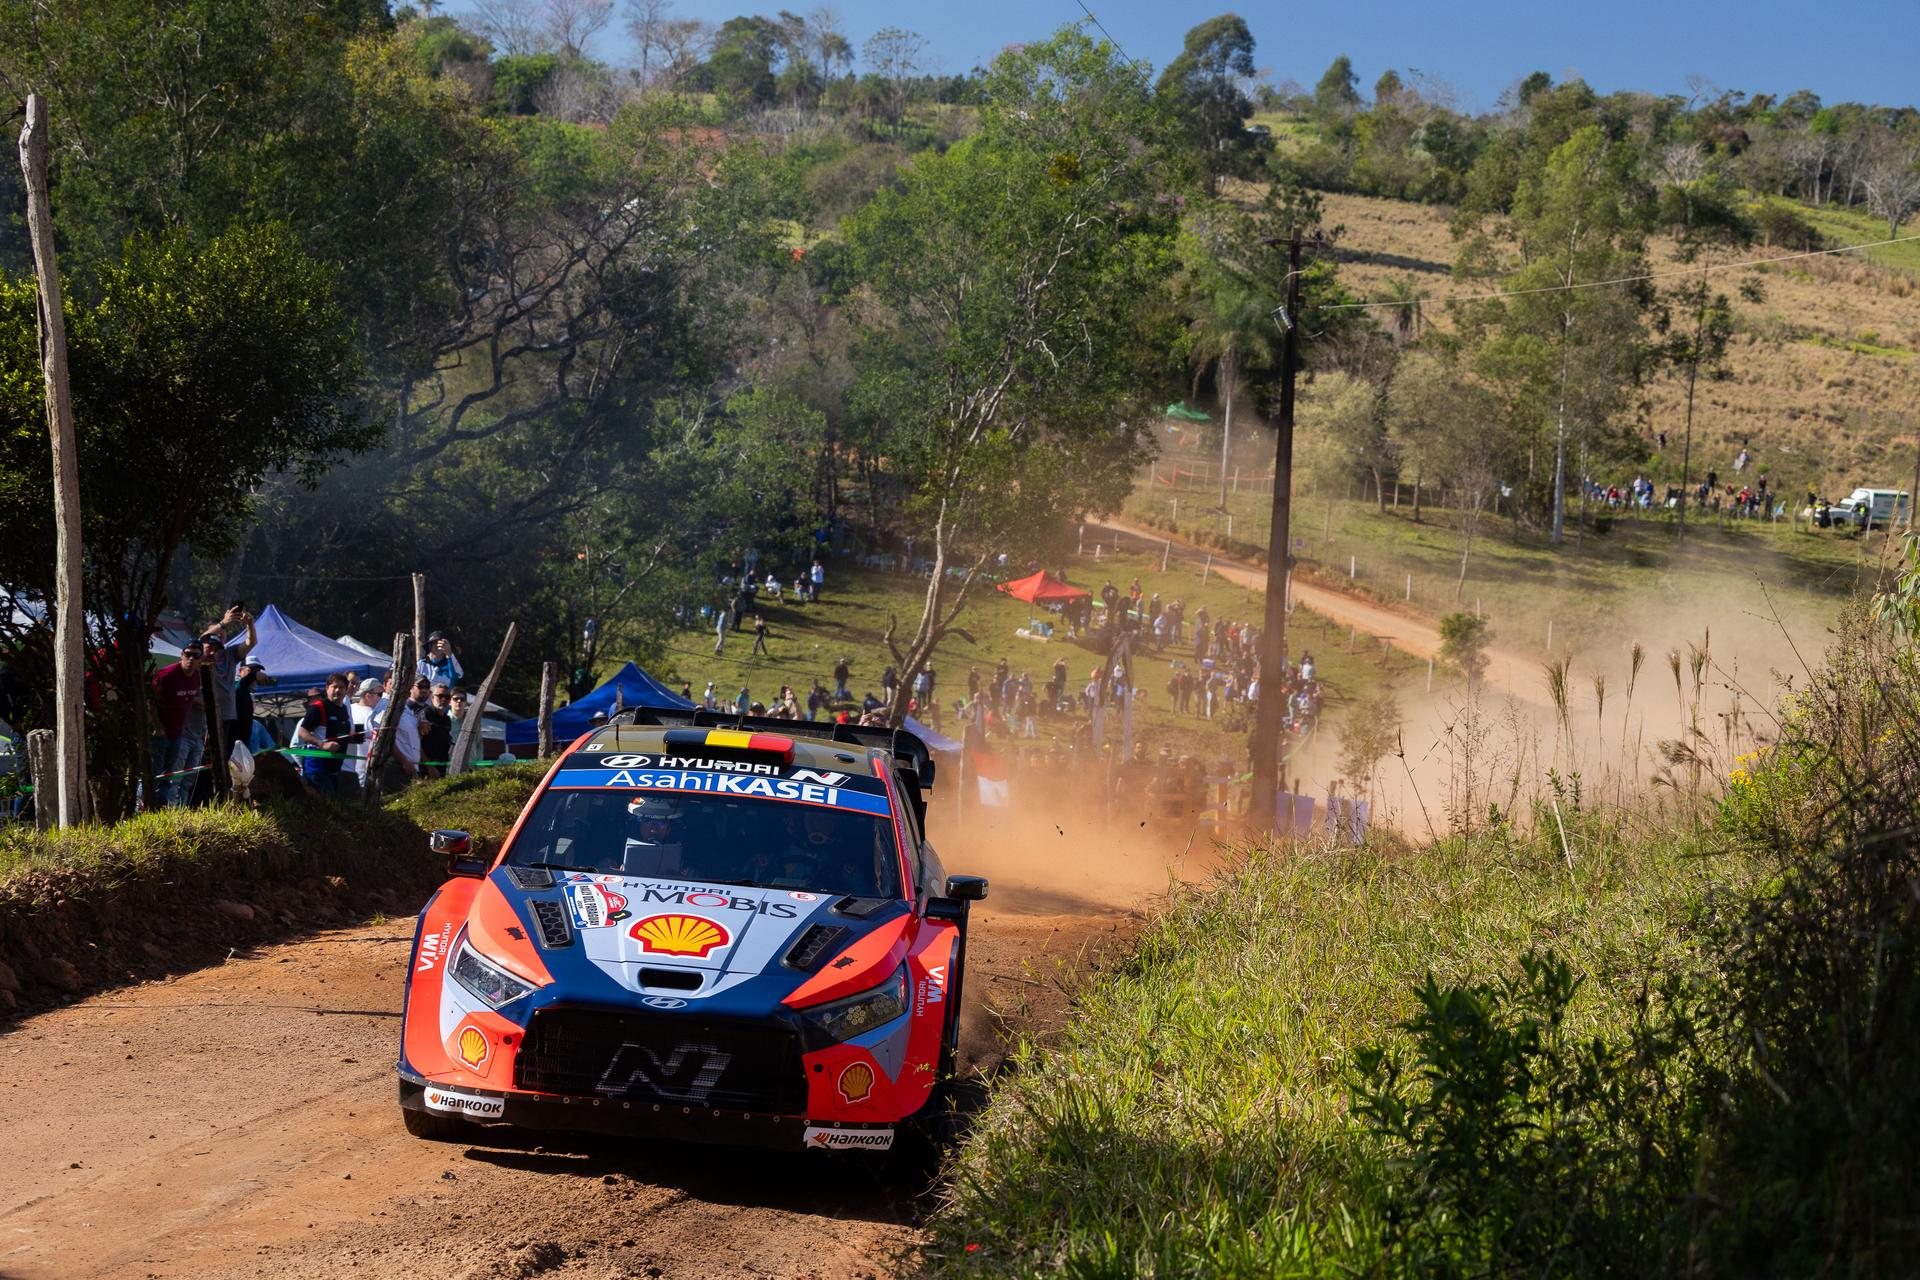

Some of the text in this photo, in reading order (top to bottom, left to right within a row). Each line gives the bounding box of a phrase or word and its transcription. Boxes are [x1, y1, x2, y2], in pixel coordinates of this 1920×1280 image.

[658, 756, 780, 776] HYUNDAI
[604, 770, 838, 806] AsahiKASEI
[623, 882, 732, 896] HYUNDAI
[641, 889, 798, 919] MOBIS
[438, 922, 453, 955] HYUNDAI
[916, 980, 927, 1017] HYUNDAI
